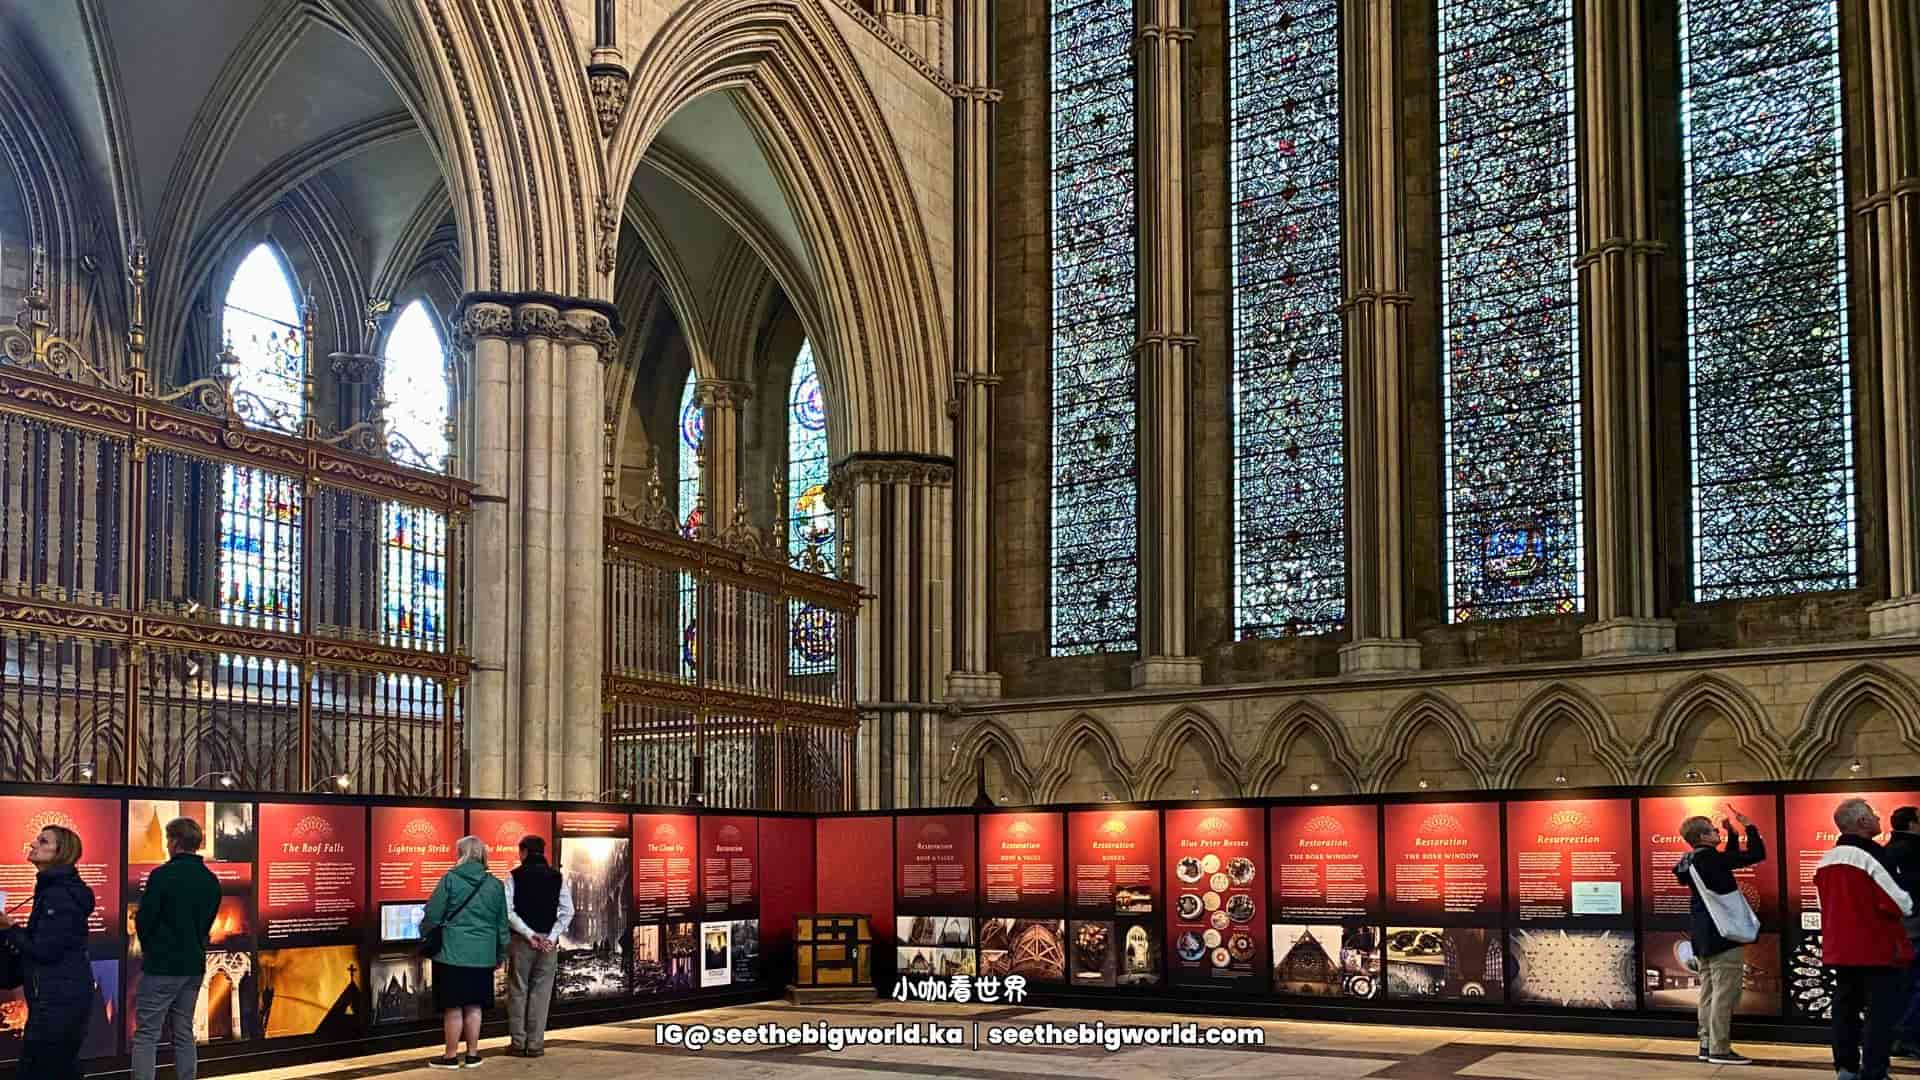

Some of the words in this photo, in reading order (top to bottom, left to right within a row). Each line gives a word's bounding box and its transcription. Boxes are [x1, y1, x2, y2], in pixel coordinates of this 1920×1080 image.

[1299, 839, 1348, 848] Restoration
[1415, 837, 1468, 847] Restoration
[1536, 834, 1600, 844] Resurrection
[283, 843, 299, 853] The
[302, 843, 321, 855] Roof
[324, 843, 344, 853] Falls
[388, 844, 426, 855] Lightning
